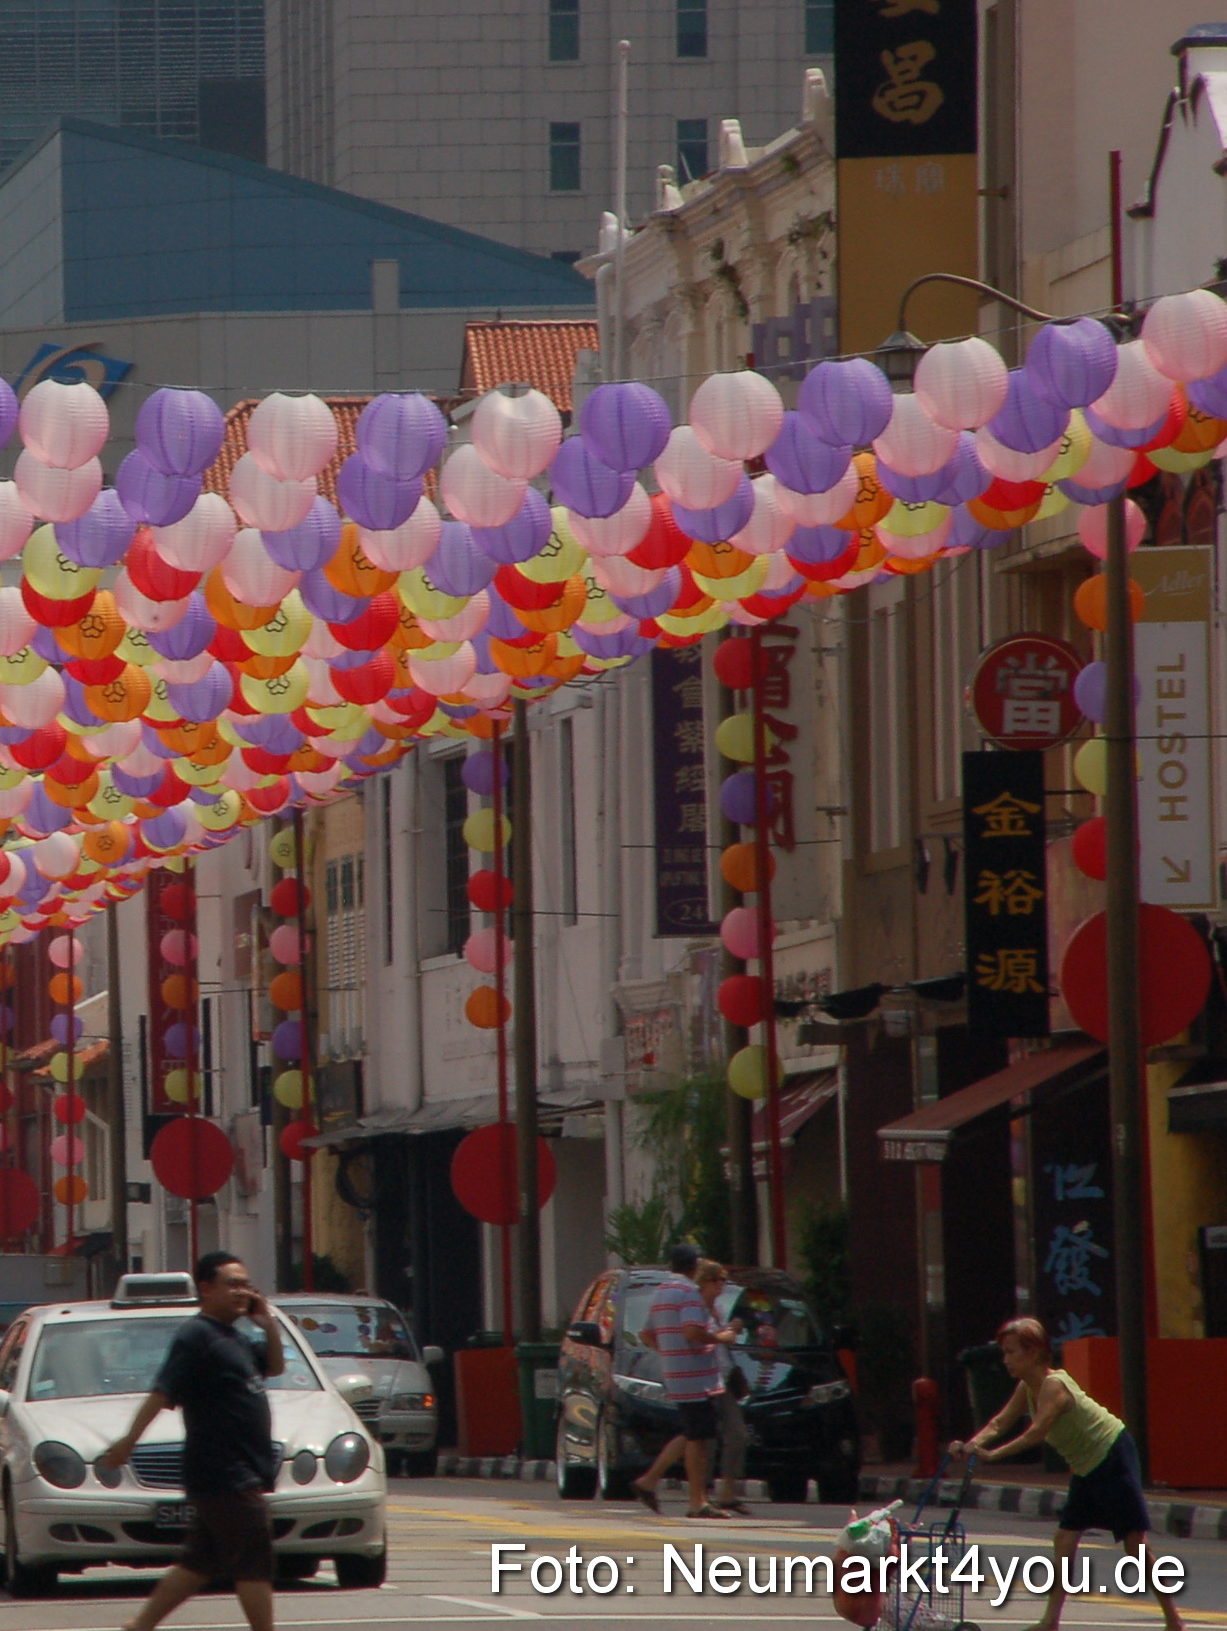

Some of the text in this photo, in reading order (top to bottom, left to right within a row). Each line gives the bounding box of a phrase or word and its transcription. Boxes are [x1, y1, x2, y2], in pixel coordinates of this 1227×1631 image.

[994, 650, 1070, 736] 當
[1156, 652, 1190, 823] HOSTEL
[969, 790, 1046, 995] 金裕源
